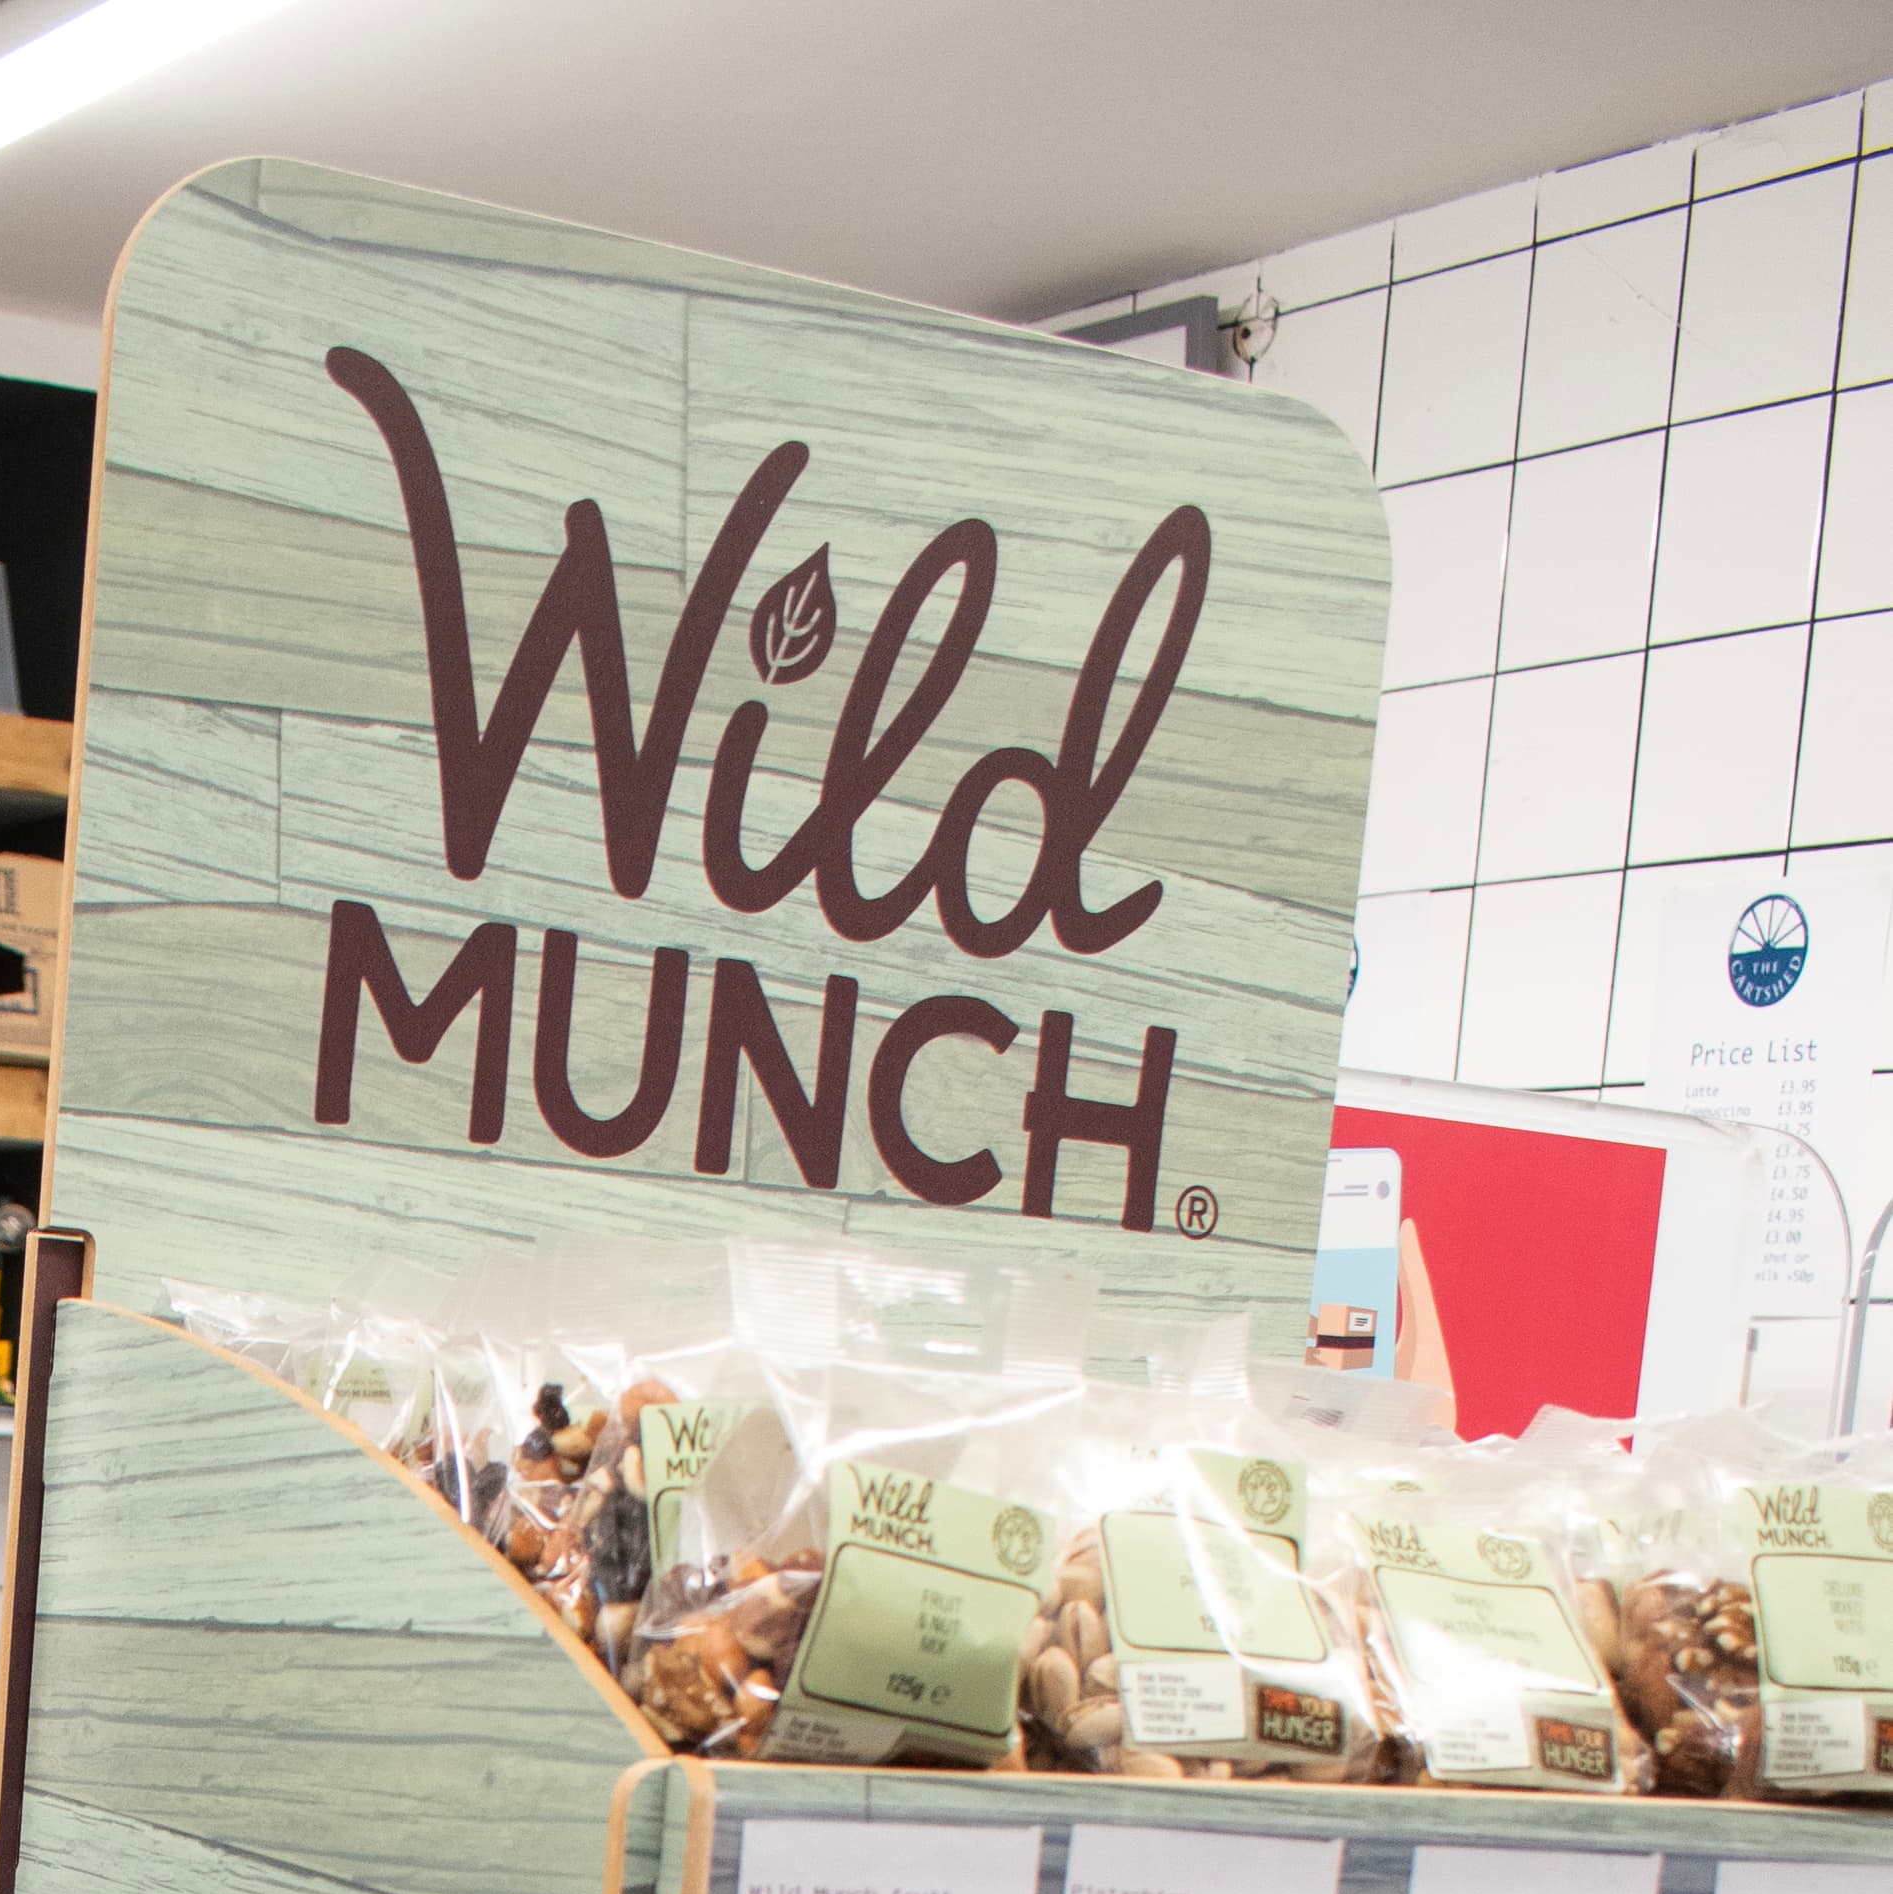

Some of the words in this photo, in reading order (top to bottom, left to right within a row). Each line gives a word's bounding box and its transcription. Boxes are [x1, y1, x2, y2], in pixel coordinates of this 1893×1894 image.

[325, 345, 1212, 959] Wild
[1730, 954, 1803, 1002] CARTSHED
[1752, 961, 1778, 975] THE
[1691, 1042, 1753, 1067] Price
[1767, 1038, 1818, 1063] List
[1781, 1079, 1816, 1095] £3.95
[850, 1464, 934, 1526] Wild
[1263, 1712, 1336, 1749] HUNGER
